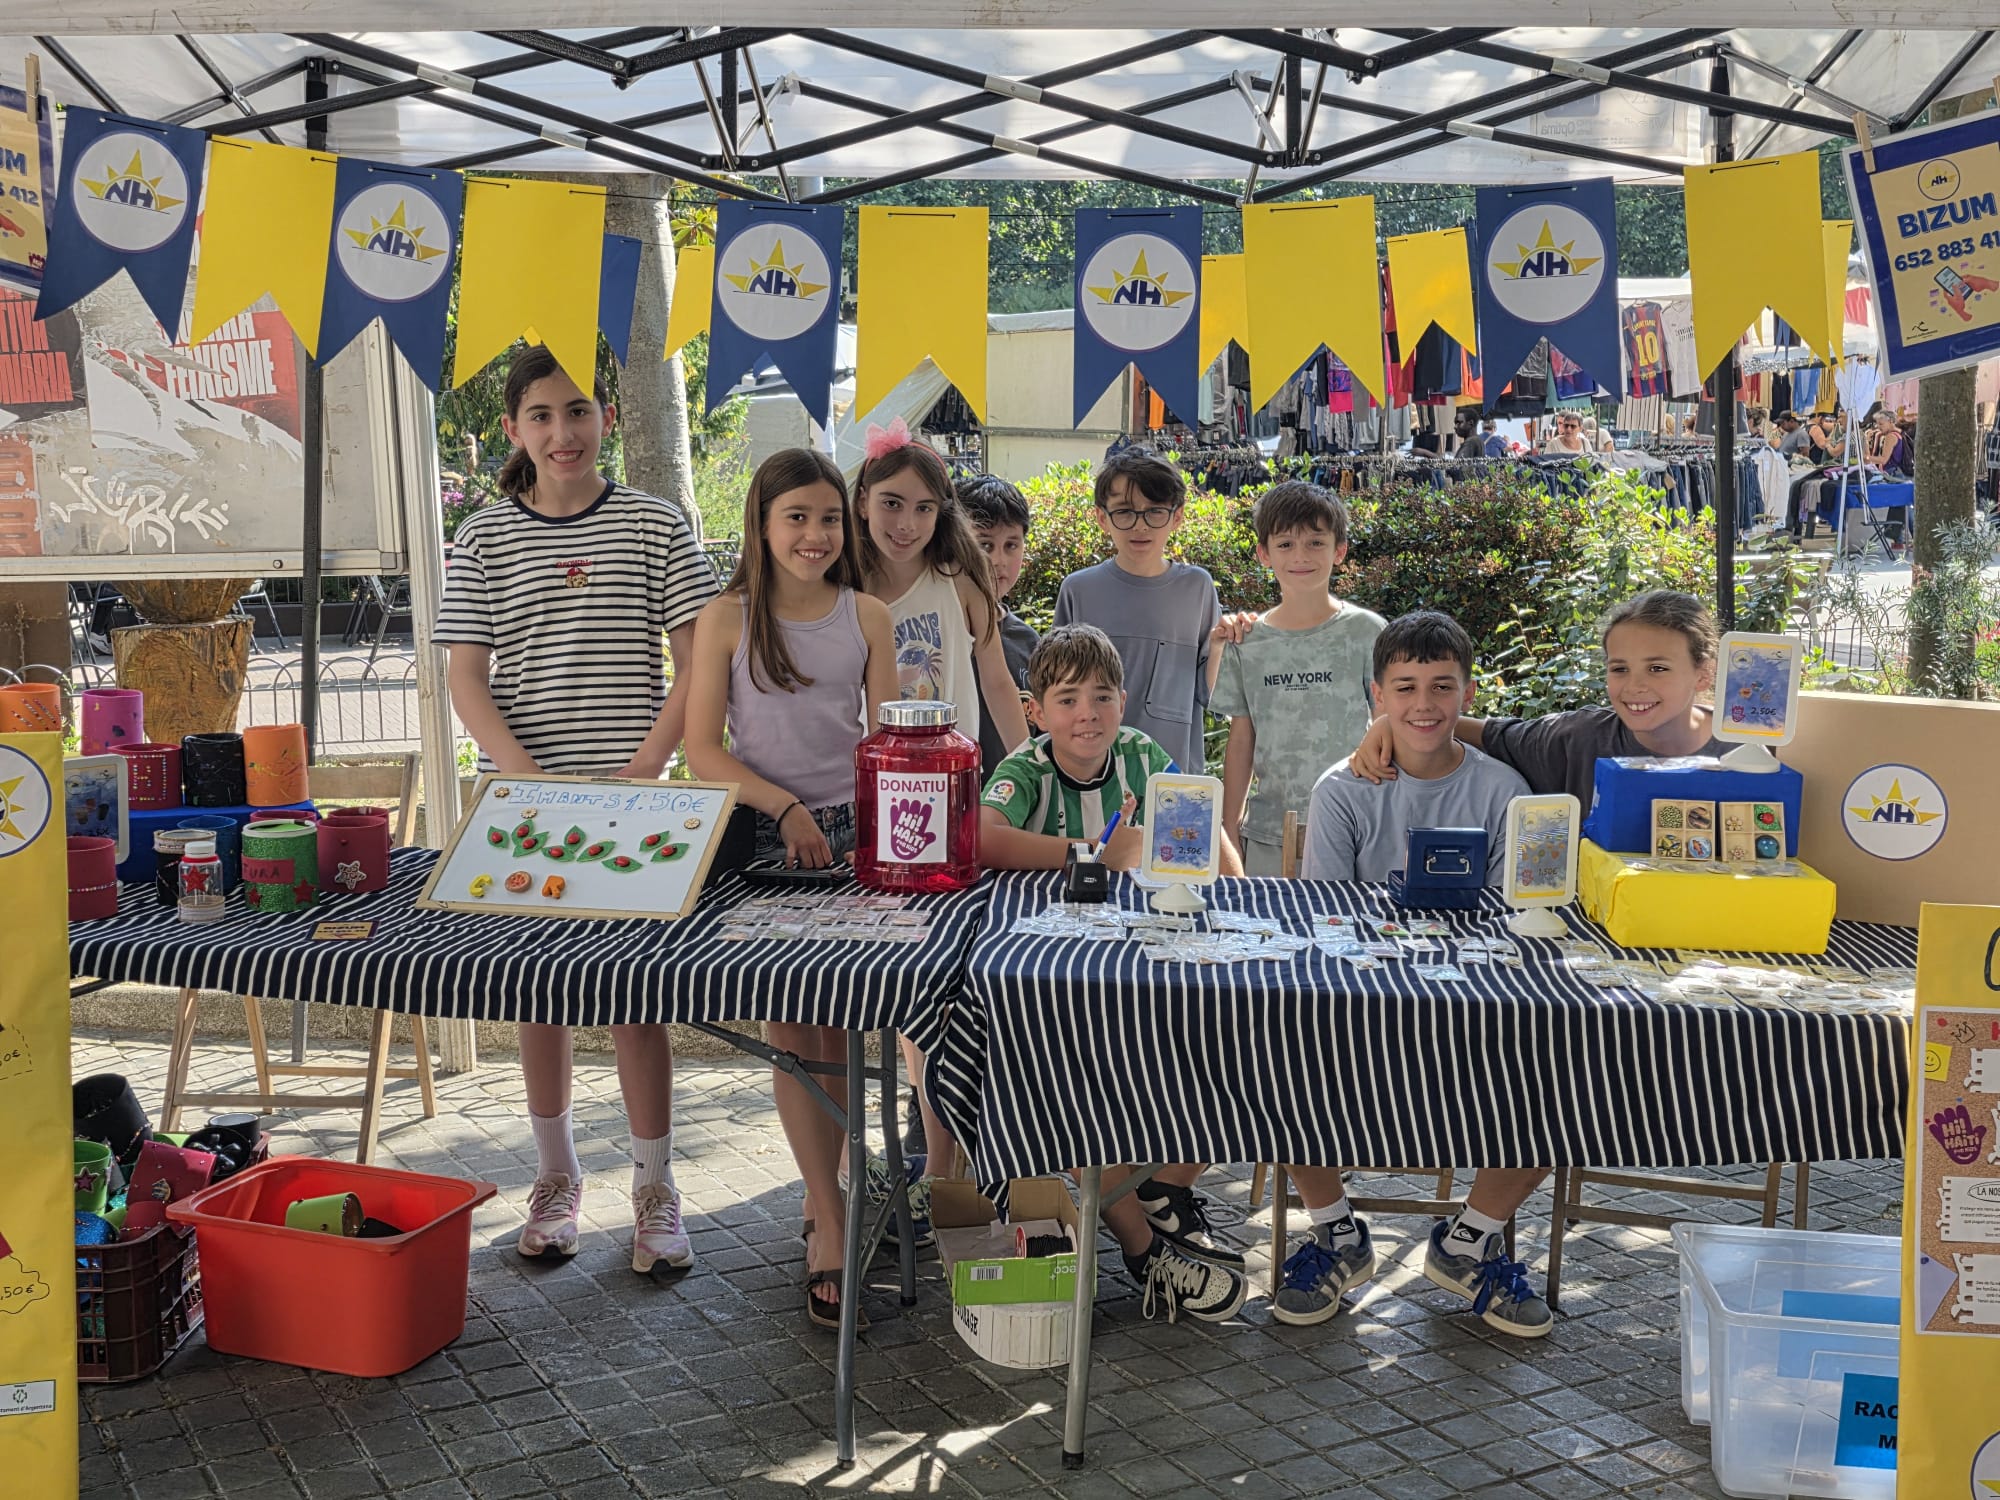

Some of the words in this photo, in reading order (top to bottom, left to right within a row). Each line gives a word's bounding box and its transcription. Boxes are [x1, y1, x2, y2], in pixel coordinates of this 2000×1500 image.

[104, 179, 154, 208] NH
[1897, 192, 1998, 239] BIZUM
[368, 229, 416, 258] NH
[1894, 248, 1934, 272] 652
[1937, 237, 1975, 261] 883
[1520, 251, 1570, 277] NH
[749, 269, 797, 296] NH
[1113, 279, 1162, 305] NH
[1635, 331, 1659, 366] 10
[1264, 673, 1294, 687] NEW
[1297, 671, 1333, 684] YORK
[880, 779, 946, 794] DONATIU
[1872, 802, 1914, 823] NH
[1976, 1187, 1987, 1196] LA
